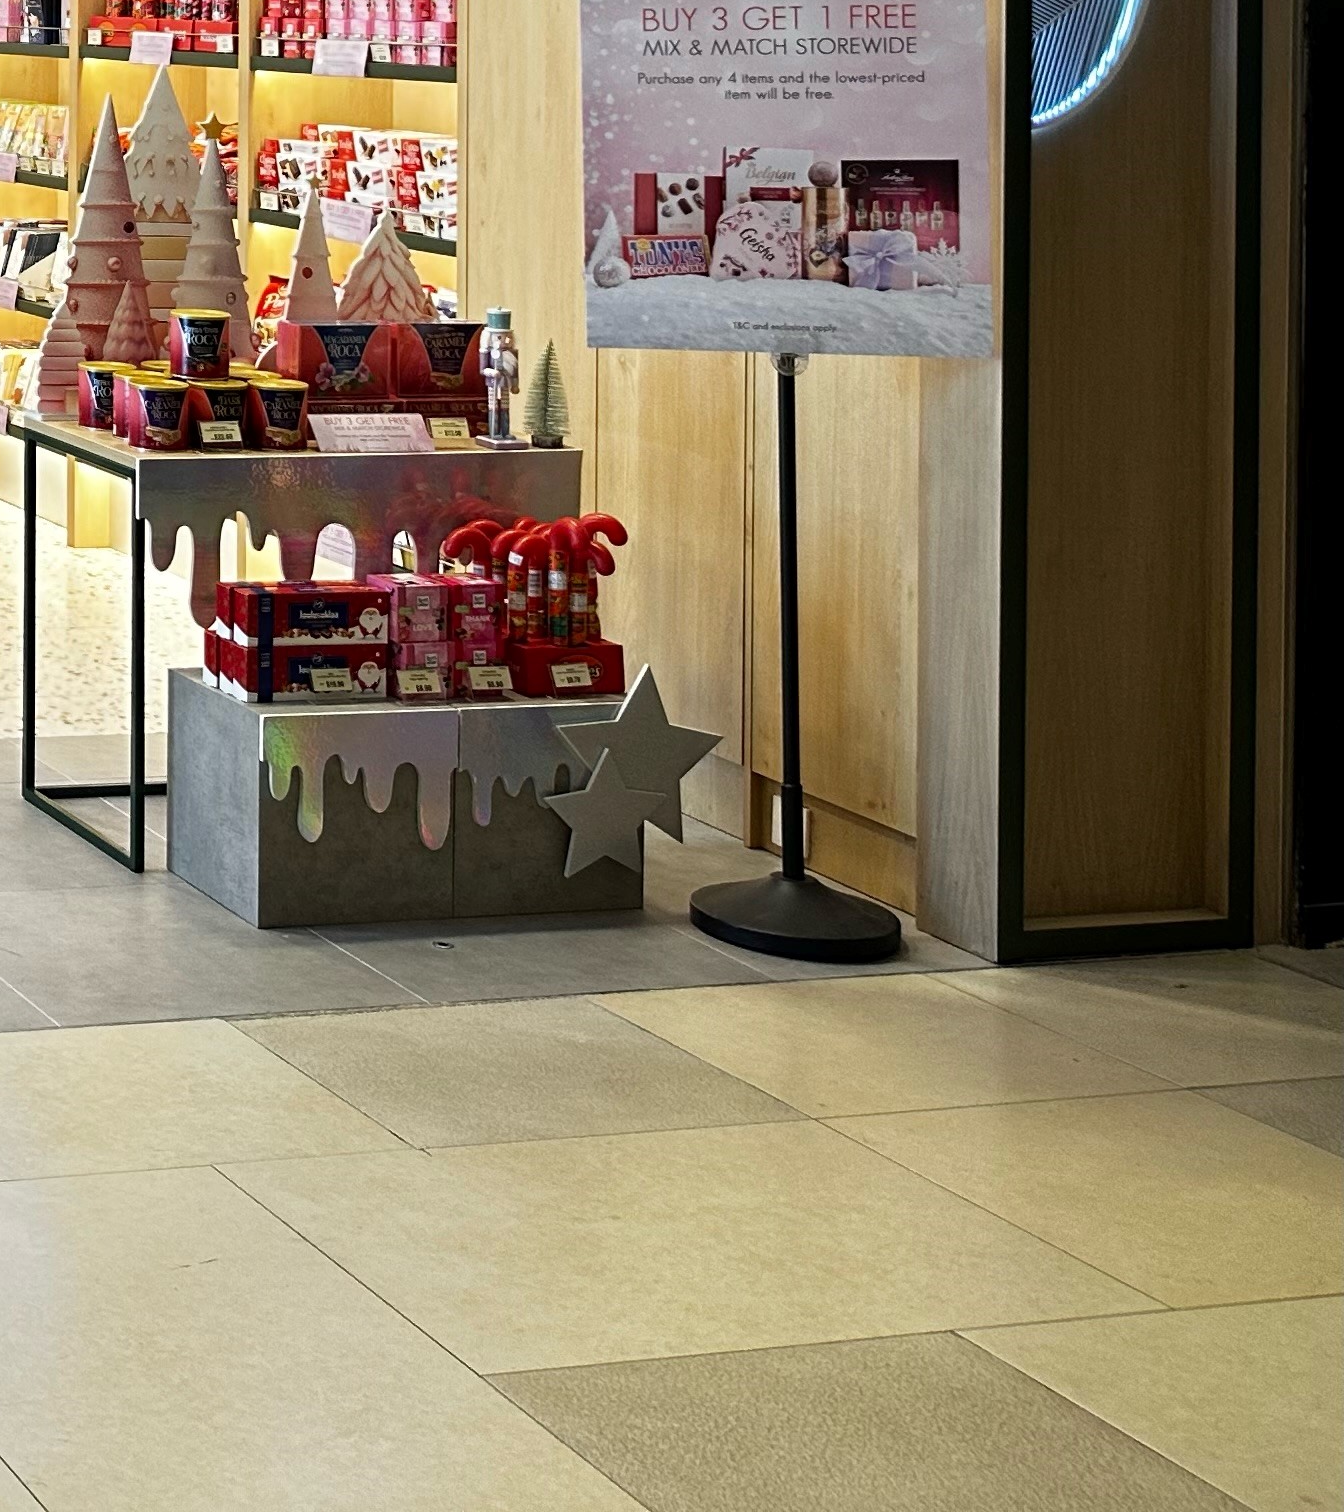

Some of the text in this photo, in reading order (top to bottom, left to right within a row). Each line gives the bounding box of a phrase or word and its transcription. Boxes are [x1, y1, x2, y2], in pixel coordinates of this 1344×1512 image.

[641, 4, 917, 32] BUY 3 GET 1 FREE
[642, 36, 918, 56] MIX & MATCH STOREWIDE
[637, 71, 926, 87] Purchase any 4 items and the lowest-priced
[724, 88, 835, 100] item will be free.
[745, 164, 797, 186] Belgian
[739, 227, 776, 263] Geisha
[752, 322, 769, 331] and
[186, 332, 220, 345] ROCA
[323, 334, 367, 345] MACADAMIA
[425, 336, 467, 348] CARAMEL
[327, 343, 362, 358] ROCA
[431, 347, 462, 360] ROCA
[150, 409, 177, 420] ROCA
[213, 404, 243, 418] ROCA
[270, 409, 297, 420] ROCA
[323, 417, 411, 425] BUY 3 GET 1 FREE
